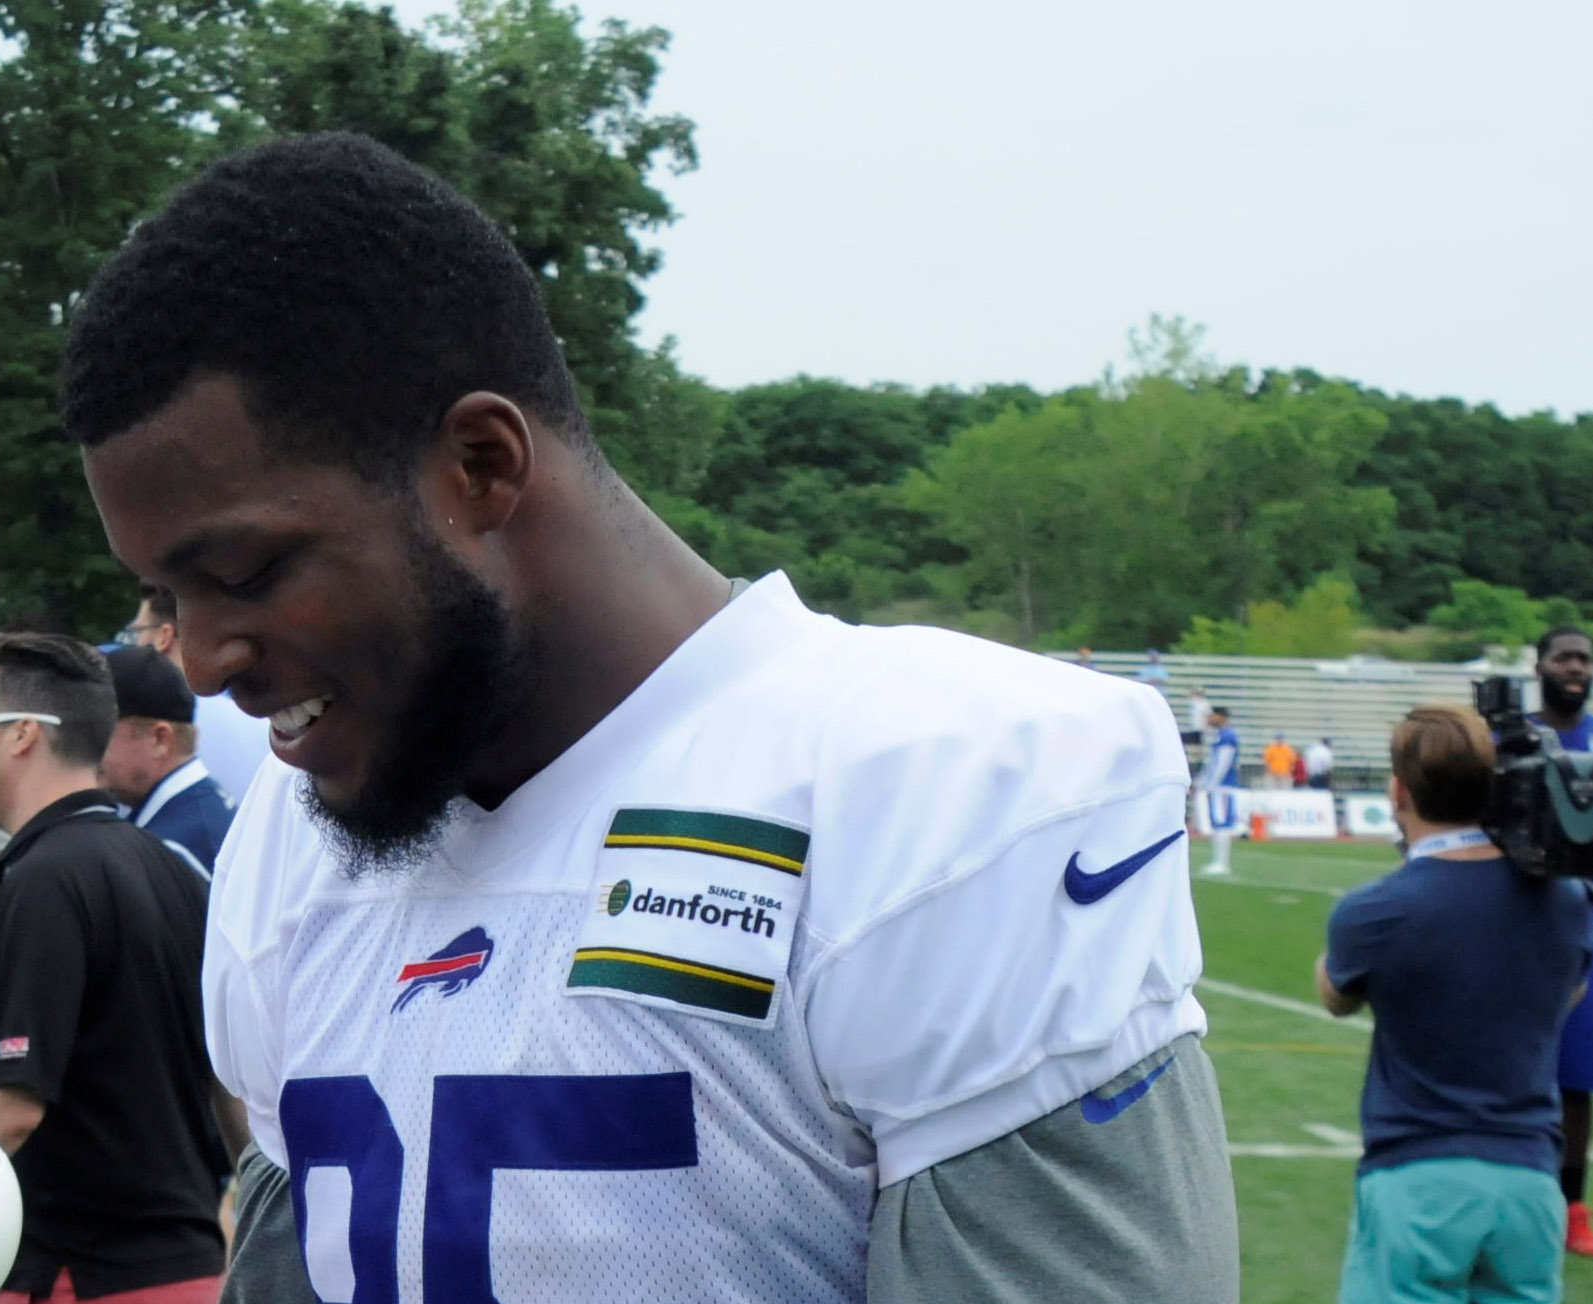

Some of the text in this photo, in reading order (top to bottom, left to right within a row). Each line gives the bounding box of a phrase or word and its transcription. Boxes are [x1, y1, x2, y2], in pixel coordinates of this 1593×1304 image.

[633, 887, 776, 938] danforth
[707, 884, 783, 911] SINCE 1884
